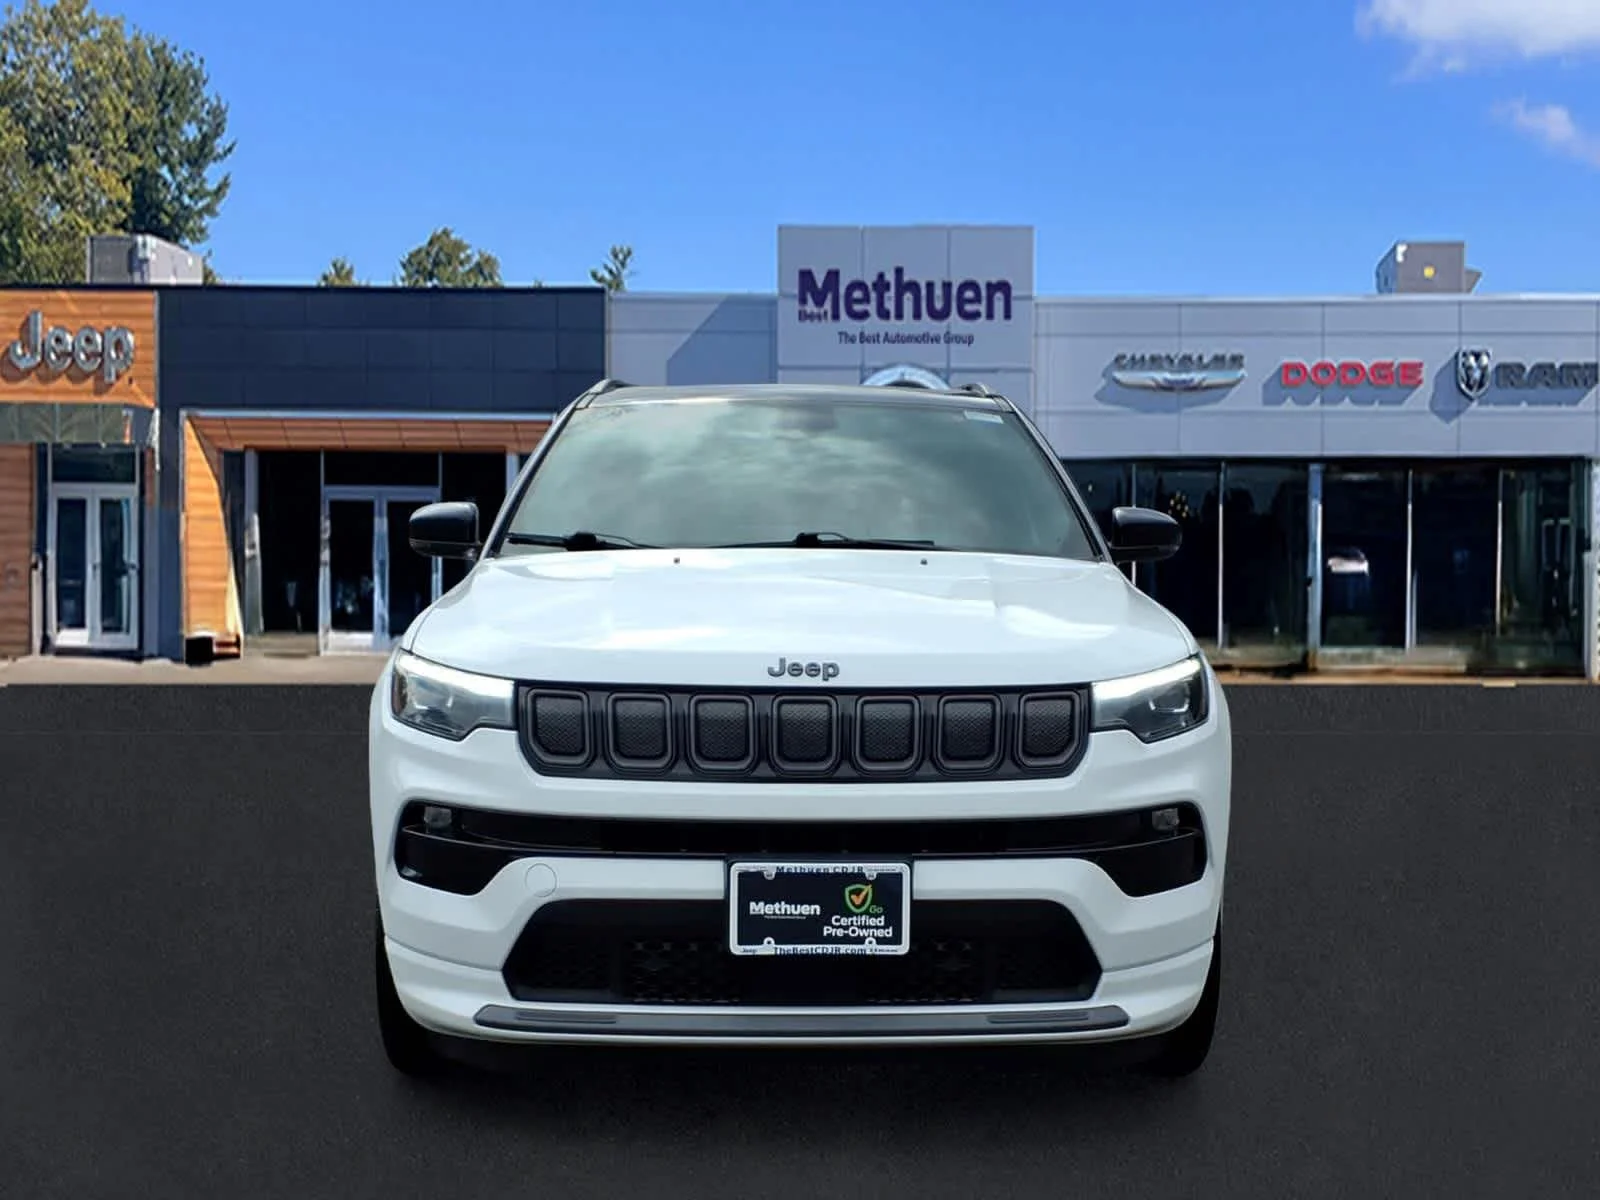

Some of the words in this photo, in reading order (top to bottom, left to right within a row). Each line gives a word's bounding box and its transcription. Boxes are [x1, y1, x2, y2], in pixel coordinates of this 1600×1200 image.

[798, 266, 1012, 321] Methuen
[798, 309, 828, 322] Best
[838, 331, 857, 344] The
[859, 331, 880, 344] Best
[883, 331, 941, 344] Automotive
[943, 331, 974, 346] Group
[9, 311, 135, 384] Jeep
[1281, 361, 1423, 386] DODGE
[1495, 362, 1599, 389] RAM
[767, 657, 840, 682] Jeep
[749, 901, 821, 915] Methuen
[869, 905, 884, 914] Go
[831, 915, 885, 926] Certified
[823, 926, 893, 937] Pre-Owned
[775, 946, 866, 955] TheBestCDJR.com
